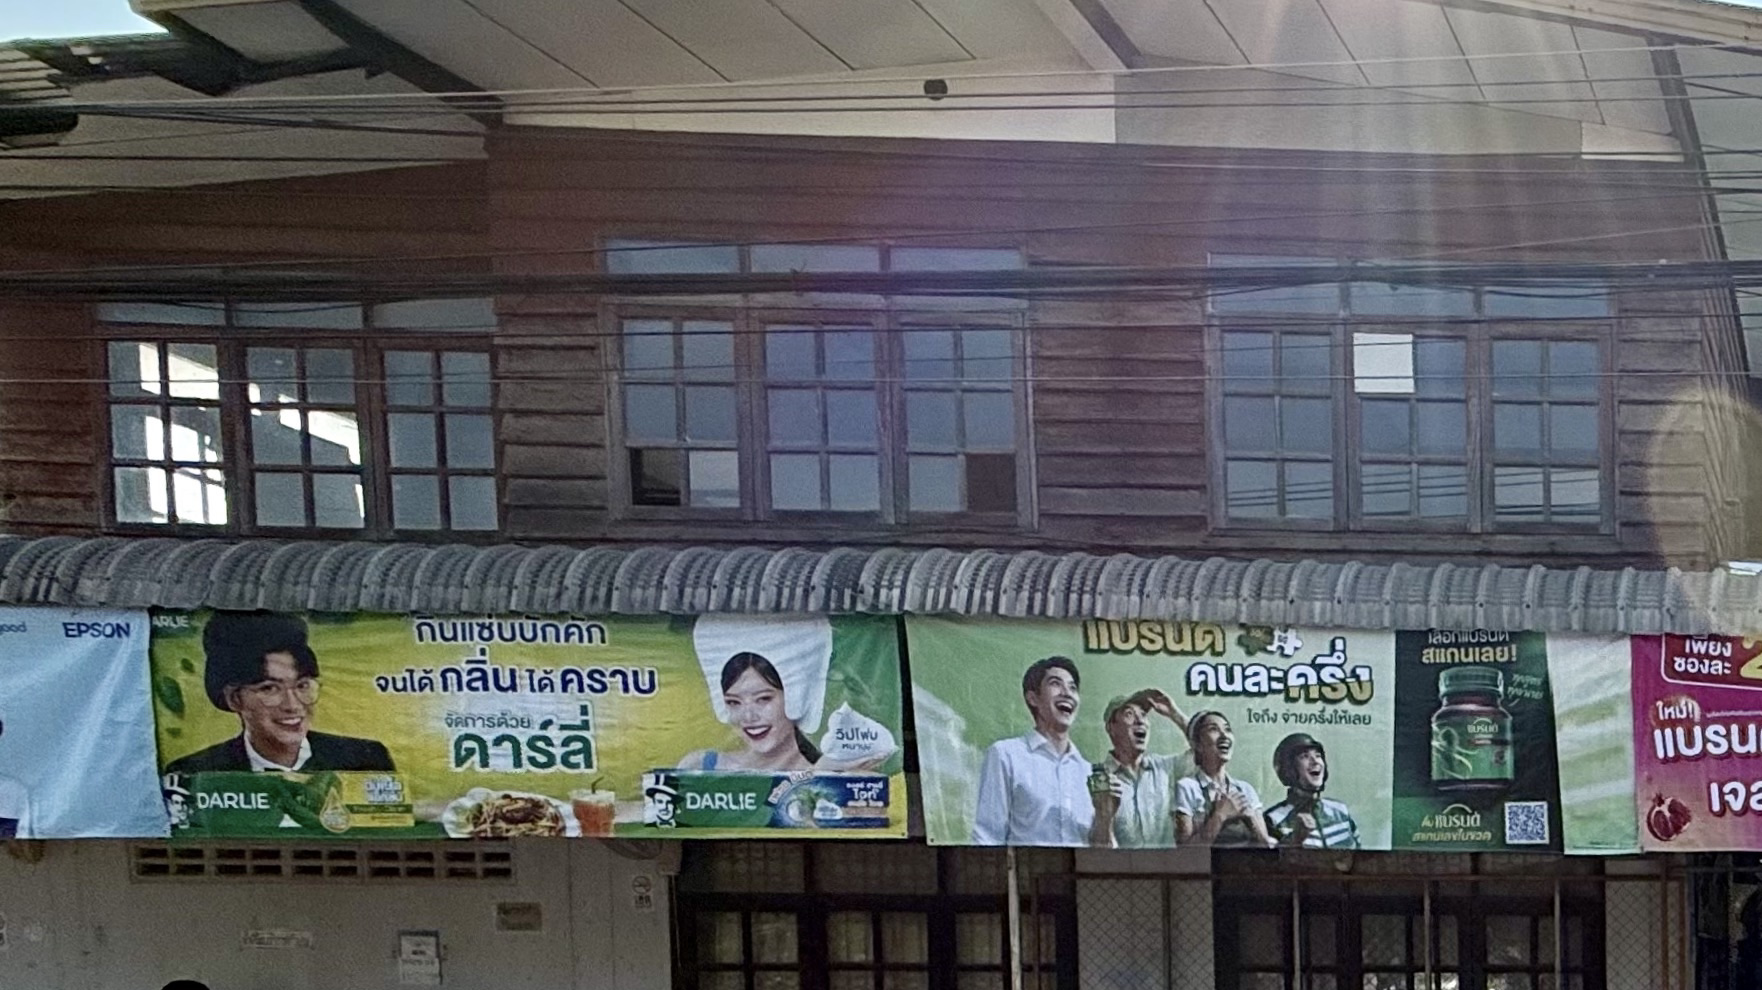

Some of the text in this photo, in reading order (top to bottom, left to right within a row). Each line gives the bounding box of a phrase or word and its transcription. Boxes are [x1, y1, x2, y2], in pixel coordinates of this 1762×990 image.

[63, 622, 131, 638] EPSON
[152, 615, 189, 629] ARLIE
[1085, 620, 1225, 653] แบรนด
[1428, 628, 1510, 644] เลอกแบรนด
[1422, 644, 1517, 664] สแกนเลย!
[376, 648, 657, 694] จนได้ กลิ่น ได้ คราบ
[1188, 637, 1374, 703] คนละครึ่ง
[1673, 656, 1731, 675] ซองละ
[1247, 706, 1372, 725] ใจถึง จ่ายครึ่งให้เลย
[1656, 699, 1694, 720] ใหม่!
[445, 712, 531, 729] จัดการด้วย
[454, 704, 593, 769] ดาร์ลี่
[197, 792, 270, 810] DARLIE
[686, 792, 757, 810] DARLIE
